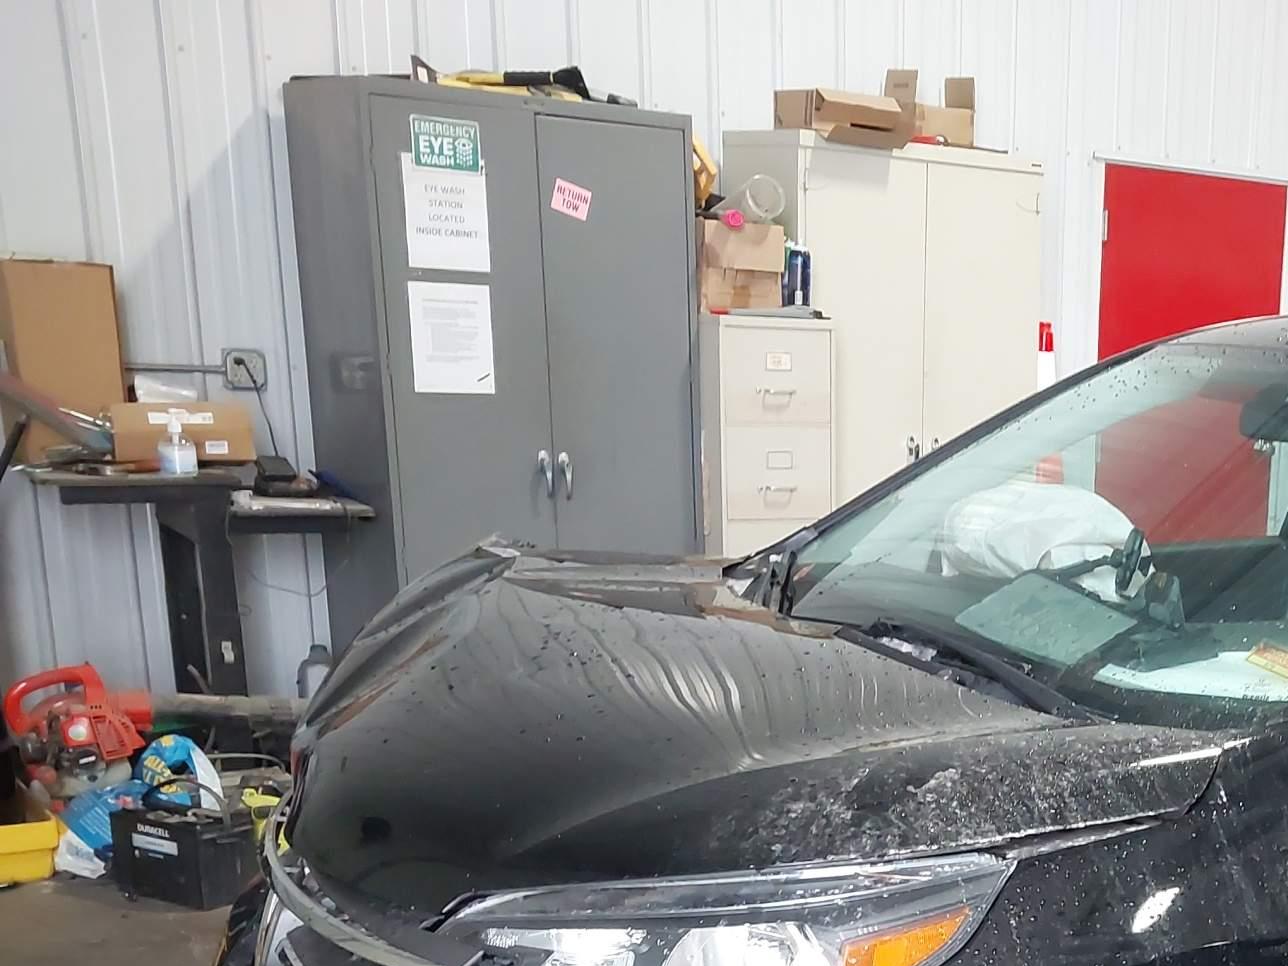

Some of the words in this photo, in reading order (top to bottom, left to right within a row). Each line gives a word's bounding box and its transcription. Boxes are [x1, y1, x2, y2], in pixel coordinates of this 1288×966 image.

[414, 119, 475, 139] EMERGENCY
[419, 135, 454, 155] EYE
[420, 152, 455, 167] WASH
[424, 183, 438, 193] EYE
[440, 184, 465, 195] WASH
[556, 184, 589, 204] RETURN
[428, 199, 463, 209] STATION
[562, 197, 580, 212] TOW
[428, 213, 465, 224] LOCATED
[416, 226, 441, 237] INSIDE
[444, 228, 479, 239] CABINET
[136, 823, 170, 838] DURACELL
